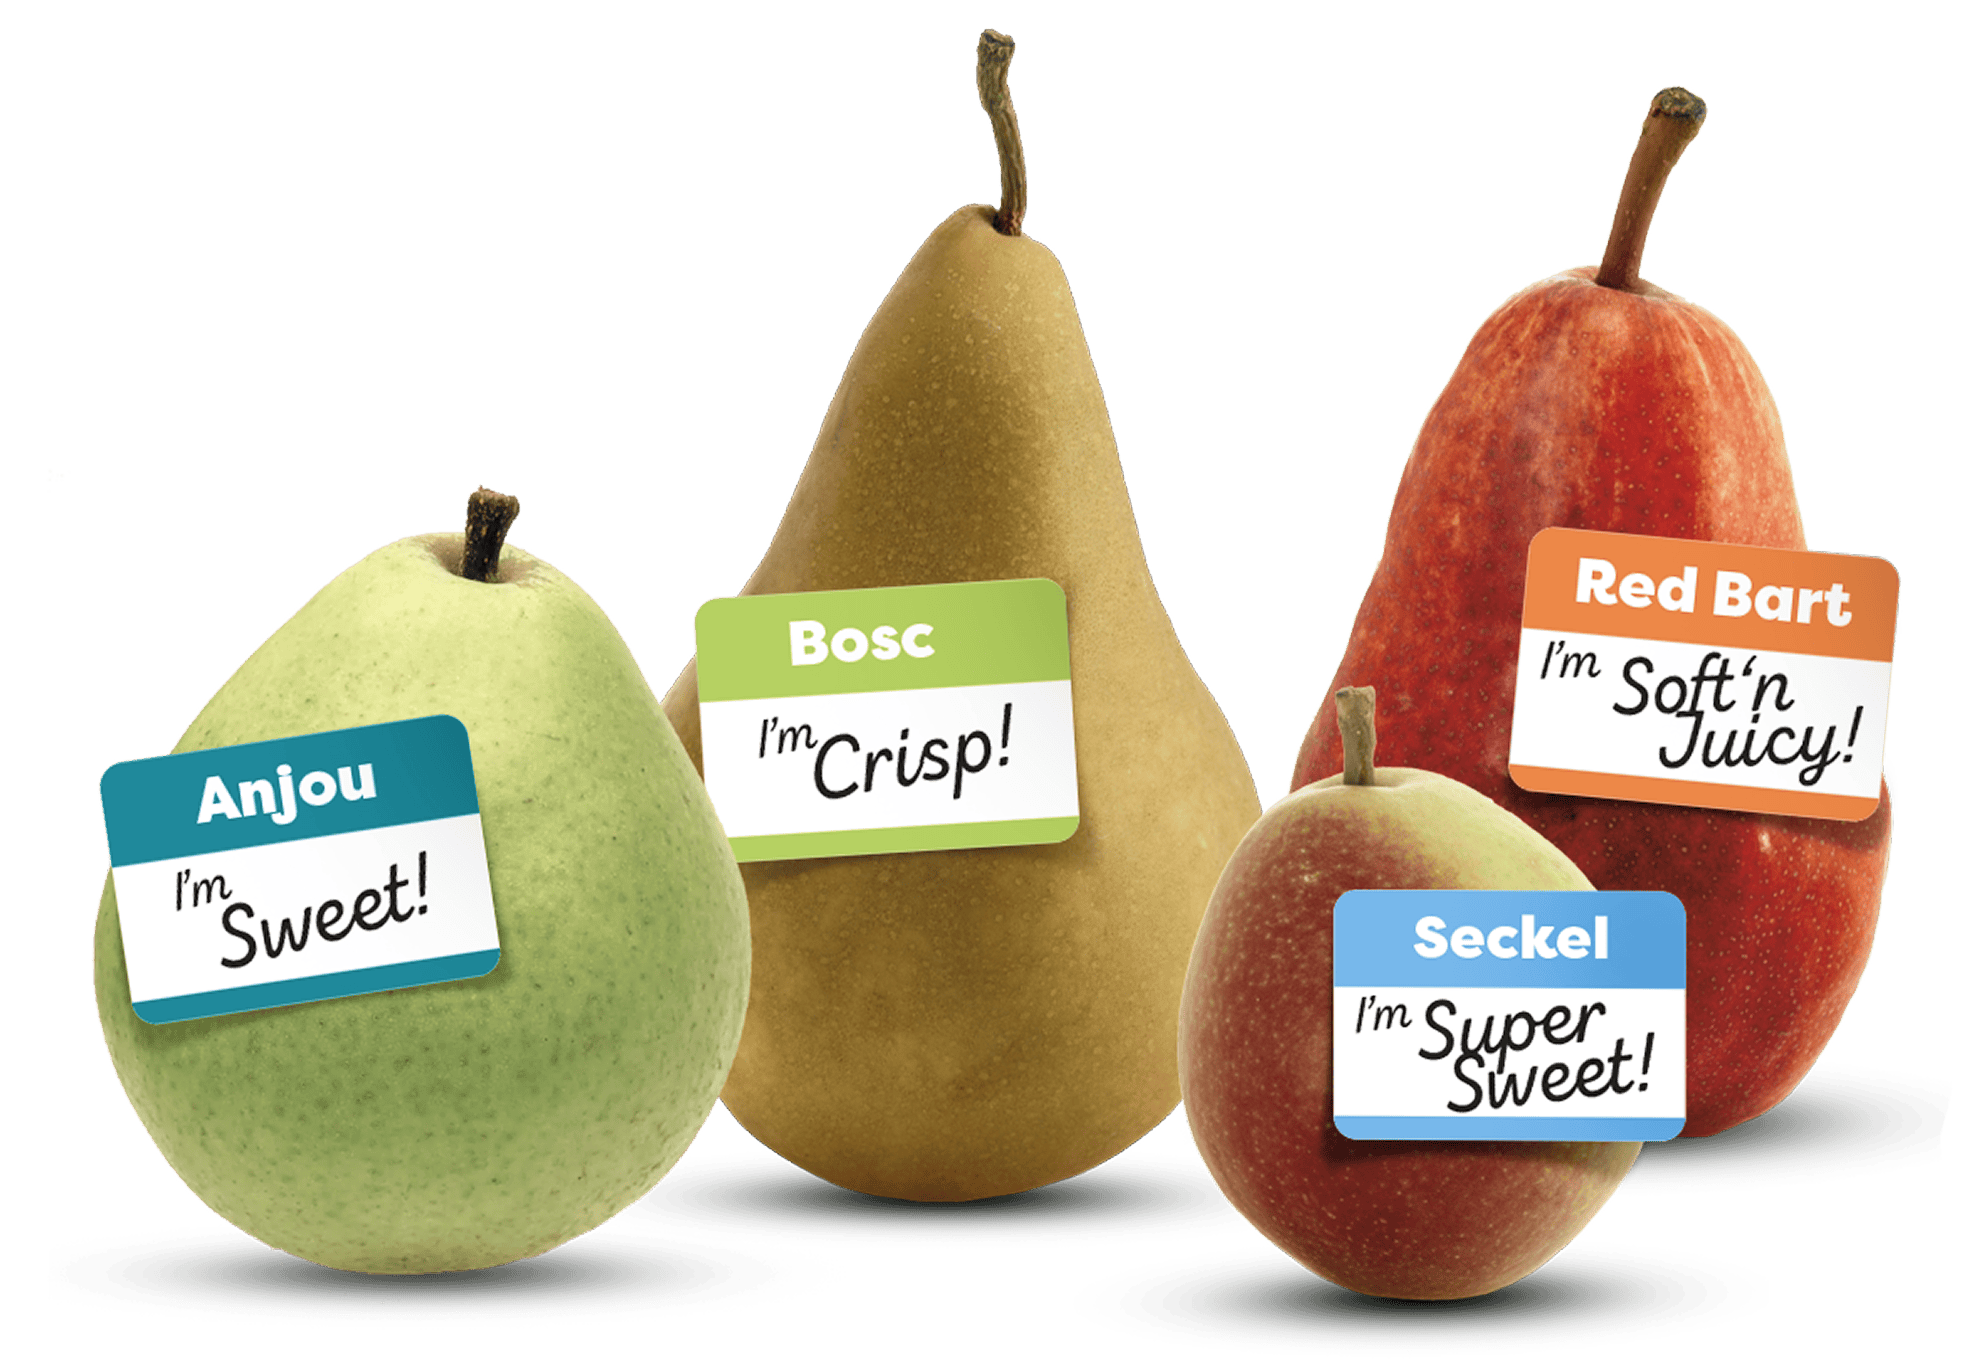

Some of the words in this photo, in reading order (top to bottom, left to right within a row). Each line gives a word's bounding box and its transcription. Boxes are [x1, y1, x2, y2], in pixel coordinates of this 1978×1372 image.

[1575, 557, 1698, 613] Red
[1713, 570, 1852, 627] Bart
[788, 620, 935, 666] Bosc
[1540, 640, 1601, 679] I'm
[759, 716, 818, 758] I'm
[813, 702, 1013, 800] Crisp!
[1658, 705, 1864, 787] Juicy!
[196, 763, 377, 825] Anjou
[176, 868, 233, 911] I'm
[220, 850, 428, 968] Sweet!
[1413, 914, 1608, 959] Seckel
[1355, 995, 1412, 1034] I'm
[1418, 999, 1606, 1075] Super
[1446, 1032, 1655, 1113] Sweet!
